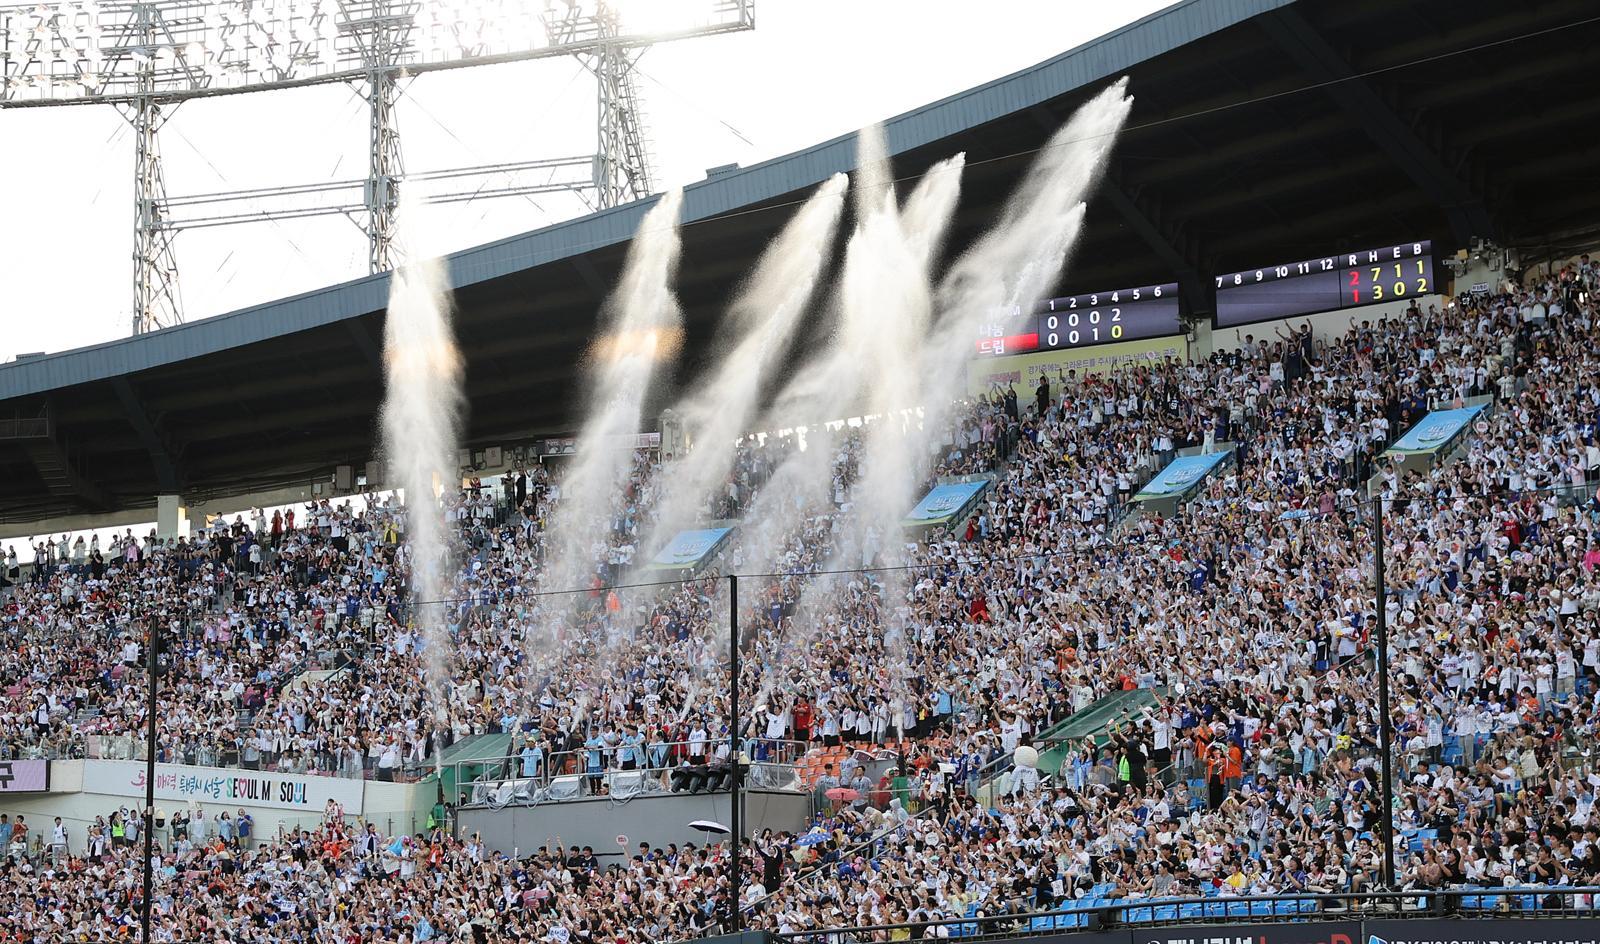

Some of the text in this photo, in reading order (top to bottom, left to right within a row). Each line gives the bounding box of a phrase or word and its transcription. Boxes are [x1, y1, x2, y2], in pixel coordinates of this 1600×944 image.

[1216, 243, 1422, 288] 7 8 9 10 11 12 R H E B
[1349, 260, 1424, 286] 2 7 1 1
[1049, 286, 1162, 311] 1 2 3 4 5 6
[1351, 278, 1428, 303] 1 3 0 2
[1047, 316, 1058, 329] 0
[1068, 313, 1079, 327] 0
[1089, 310, 1100, 324] 0
[1111, 308, 1121, 322] 2
[979, 325, 1122, 354] 드림 0 0 1 0
[179, 774, 202, 795] 특별시
[203, 775, 225, 799] 서울
[279, 781, 308, 804] SOUL
